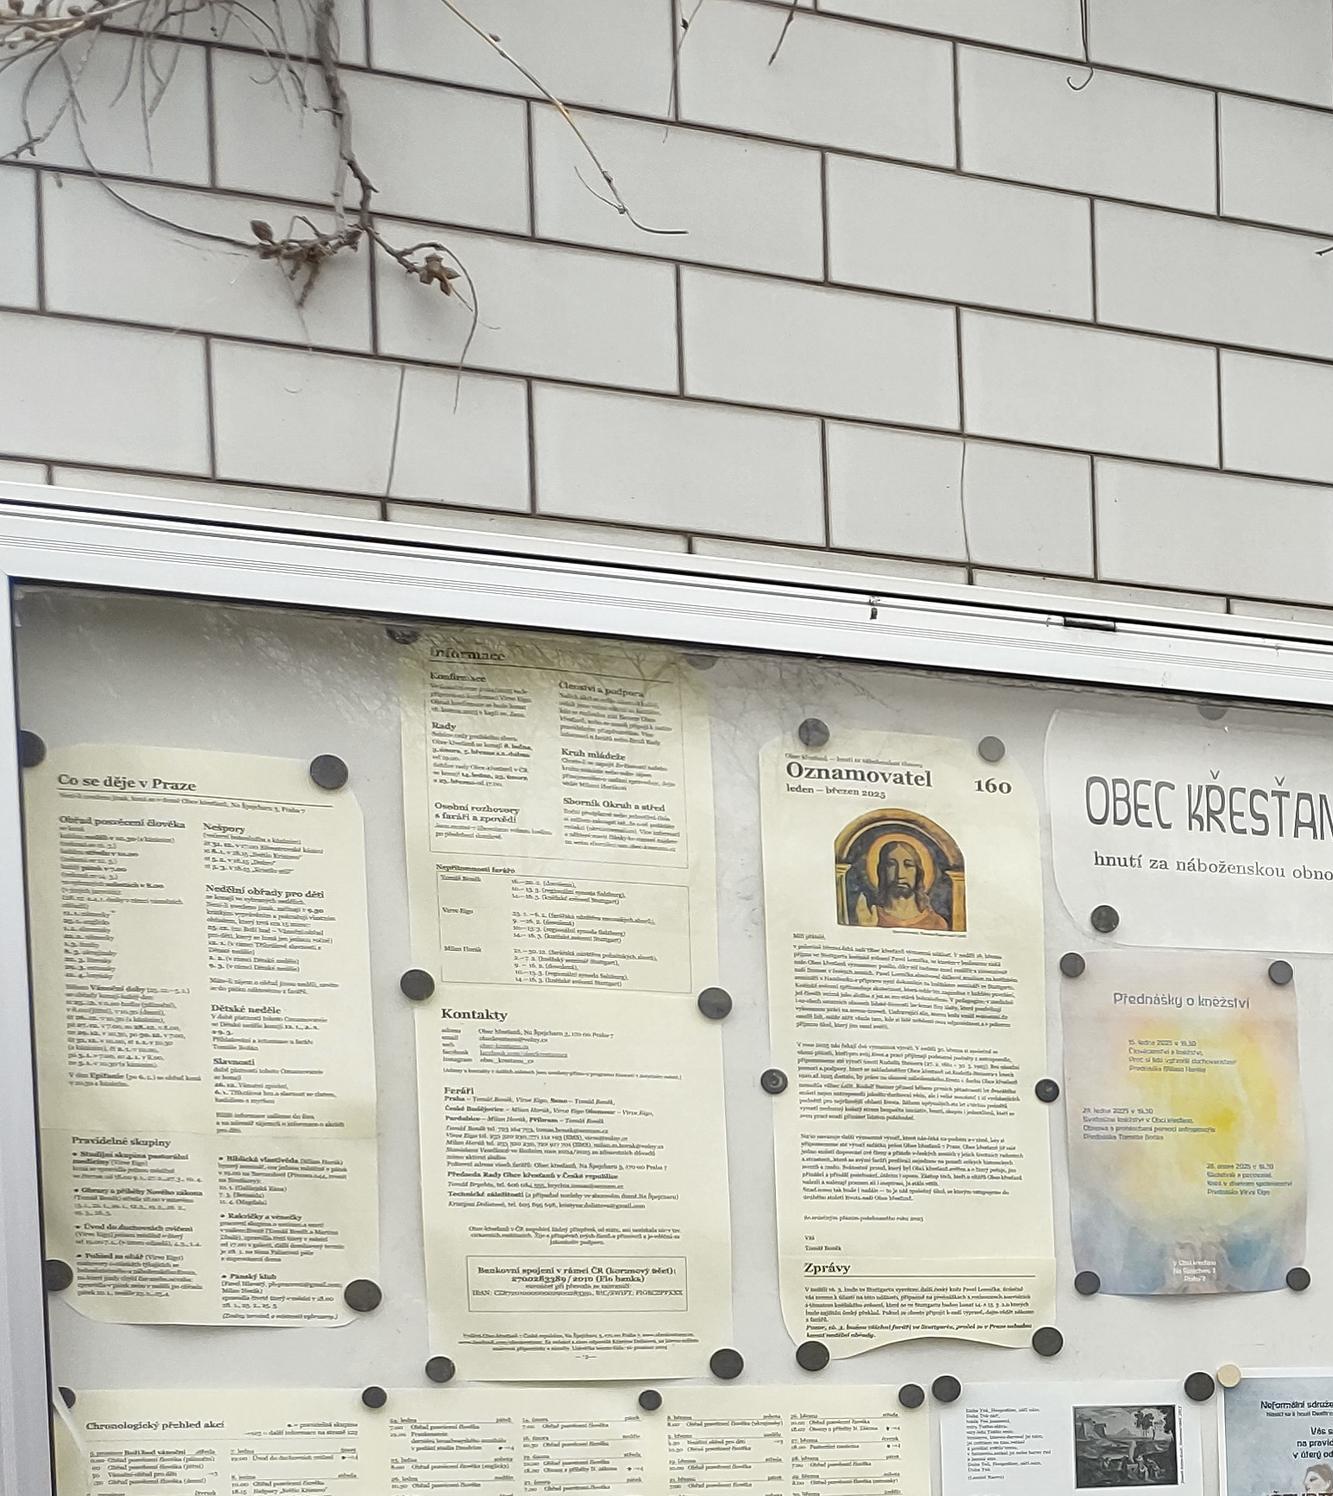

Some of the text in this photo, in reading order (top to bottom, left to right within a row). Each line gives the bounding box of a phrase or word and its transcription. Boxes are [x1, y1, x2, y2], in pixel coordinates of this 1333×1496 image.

[432, 722, 456, 731] Rady
[562, 749, 625, 761] Kruh mládeže
[786, 761, 932, 788] Oznamovatel
[58, 774, 196, 791] Co se děje v Praze
[975, 778, 1012, 794] 160
[786, 784, 886, 799] leden březen 2025
[435, 802, 520, 815] Osobní rozhovory
[563, 798, 599, 807] Sborník
[602, 800, 631, 809] Okruh
[642, 802, 665, 812] střed
[1085, 775, 1175, 829] OBEC
[59, 815, 92, 825] Obřad
[147, 819, 186, 829] člověka
[203, 822, 245, 834] Nešpory
[1094, 851, 1142, 868] hnutí
[1150, 857, 1168, 870] za
[1176, 859, 1286, 878] náboženskou
[206, 885, 324, 899] Nedělní obřady pro děti
[1113, 992, 1250, 1009] Přednášky o kněžství
[211, 1004, 281, 1015] Dětské neděle
[441, 1009, 507, 1022] Kontakty
[444, 1086, 474, 1095] Faráři
[72, 1136, 171, 1148] Pravidelné skupiny
[478, 1267, 520, 1275] Bankovní
[522, 1268, 553, 1276] spojení
[591, 1266, 603, 1274] ČR
[804, 1262, 850, 1275] Zprávy
[1261, 1401, 1305, 1410] Neformální
[86, 1420, 224, 1431] Chronologický přehled akcí
[1311, 1427, 1326, 1435] Vás
[1301, 1450, 1321, 1460] úterý
